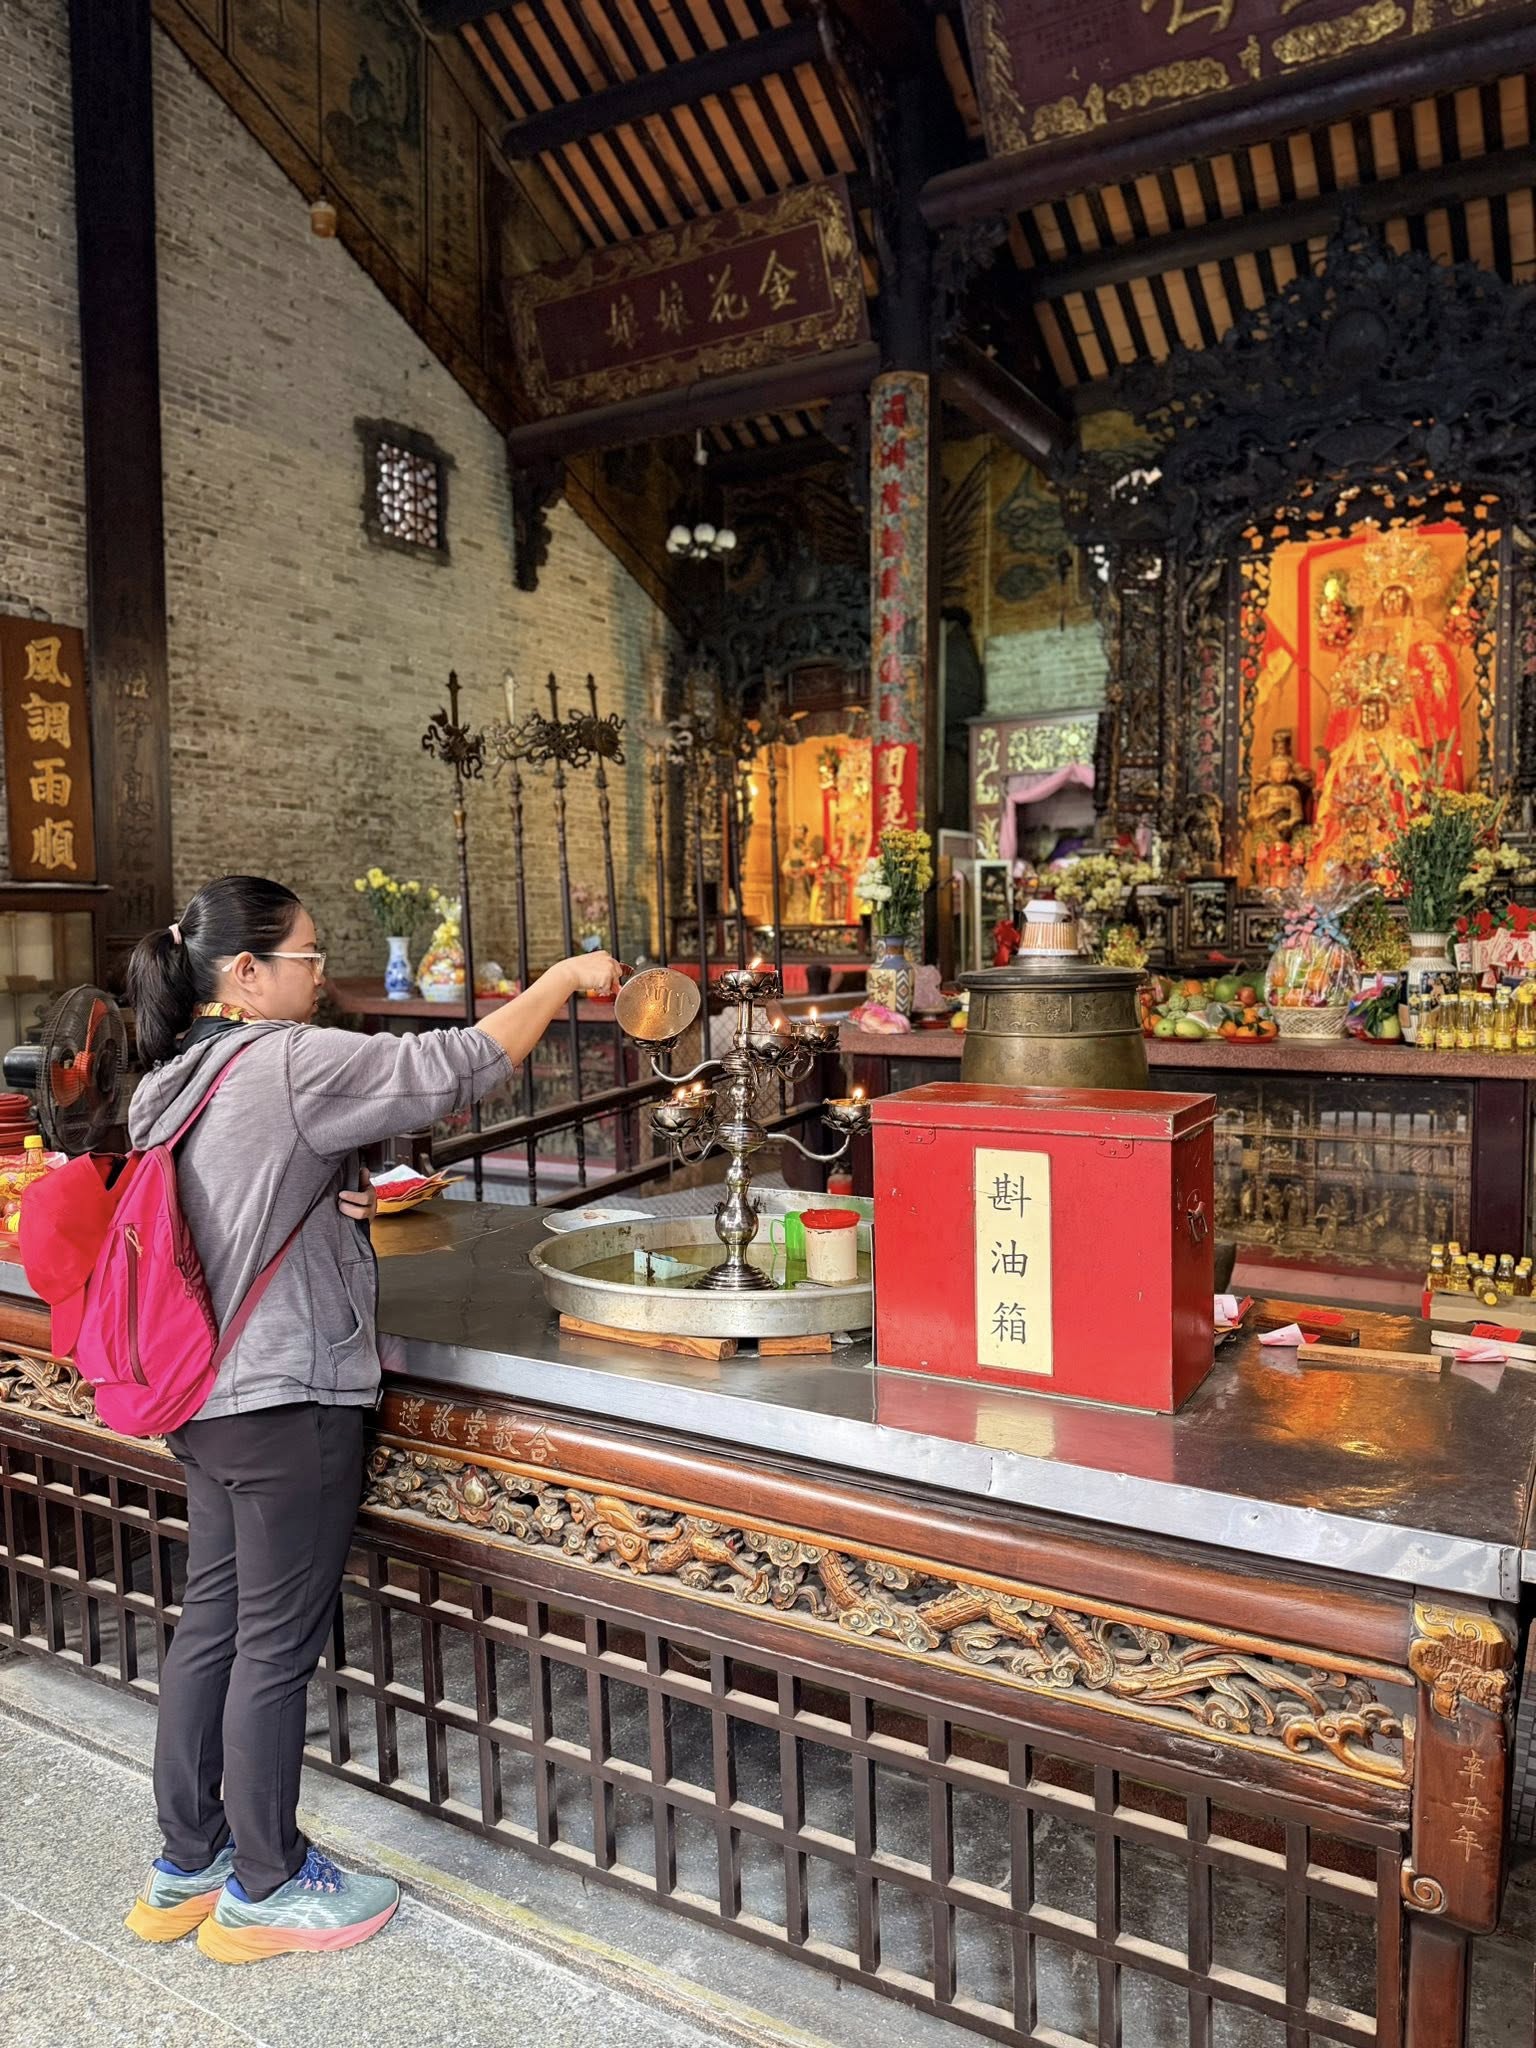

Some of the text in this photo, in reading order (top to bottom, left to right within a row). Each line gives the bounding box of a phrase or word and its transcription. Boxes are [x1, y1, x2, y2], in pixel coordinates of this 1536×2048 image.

[21, 636, 77, 871] 風調雨順
[988, 1173, 1032, 1345] 斟油箱
[1450, 1750, 1490, 1863] 辛丑年
